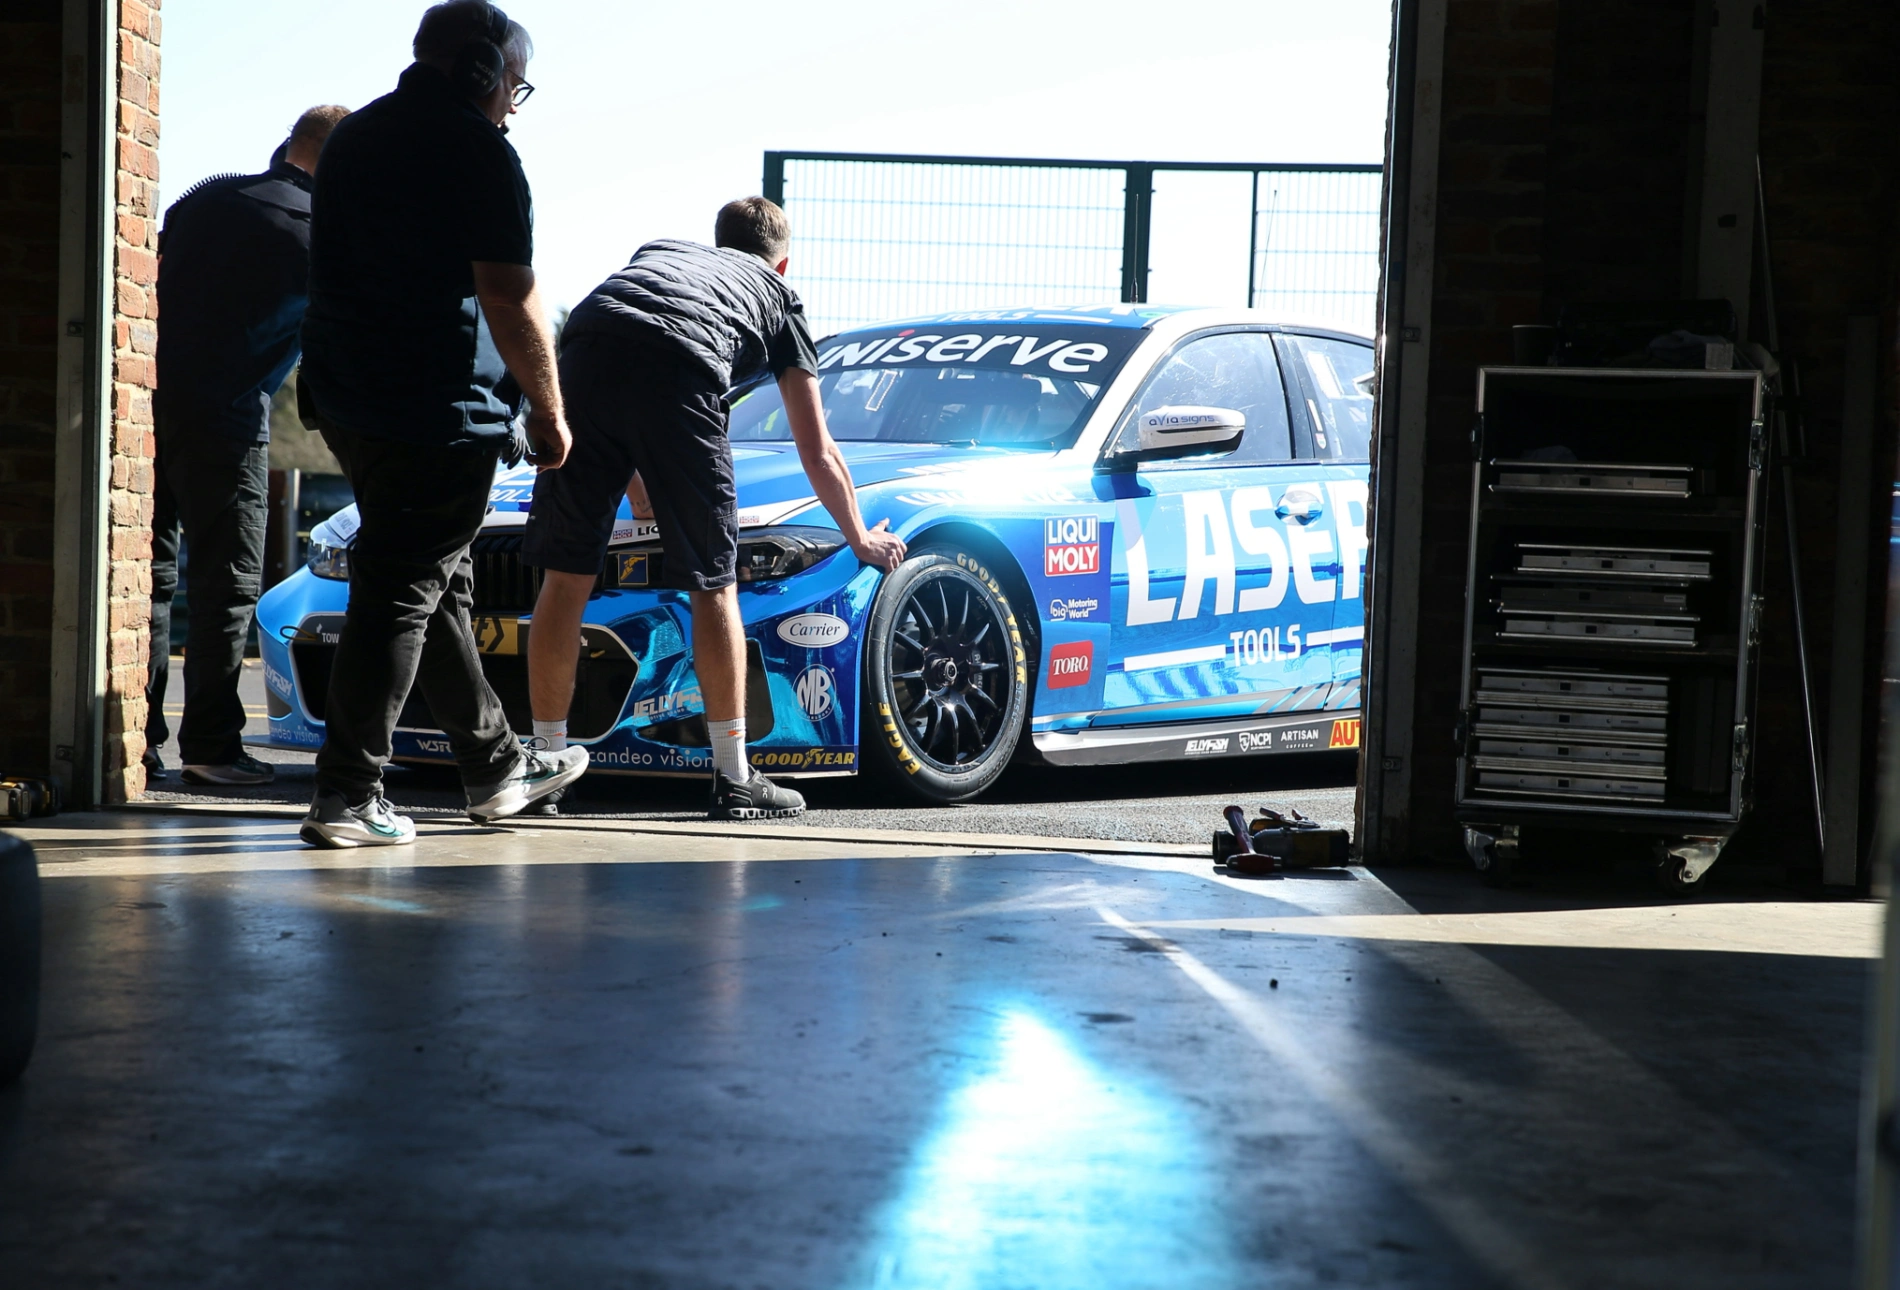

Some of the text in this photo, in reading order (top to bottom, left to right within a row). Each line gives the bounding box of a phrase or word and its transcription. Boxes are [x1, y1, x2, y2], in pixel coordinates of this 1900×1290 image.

[1048, 517, 1096, 544] LIQUI
[1048, 546, 1098, 573] MOLY
[1068, 597, 1098, 610] Motoring
[1068, 608, 1089, 619] World
[790, 622, 841, 636] Carrier
[322, 632, 339, 644] TOW
[1230, 624, 1301, 667] TOOLS
[797, 668, 832, 715] MB
[878, 702, 921, 775] EAGLE
[1250, 732, 1272, 747] NCPI
[1281, 729, 1319, 742] ARTISAN
[416, 739, 452, 753] WSR
[588, 746, 714, 768] candeo vision
